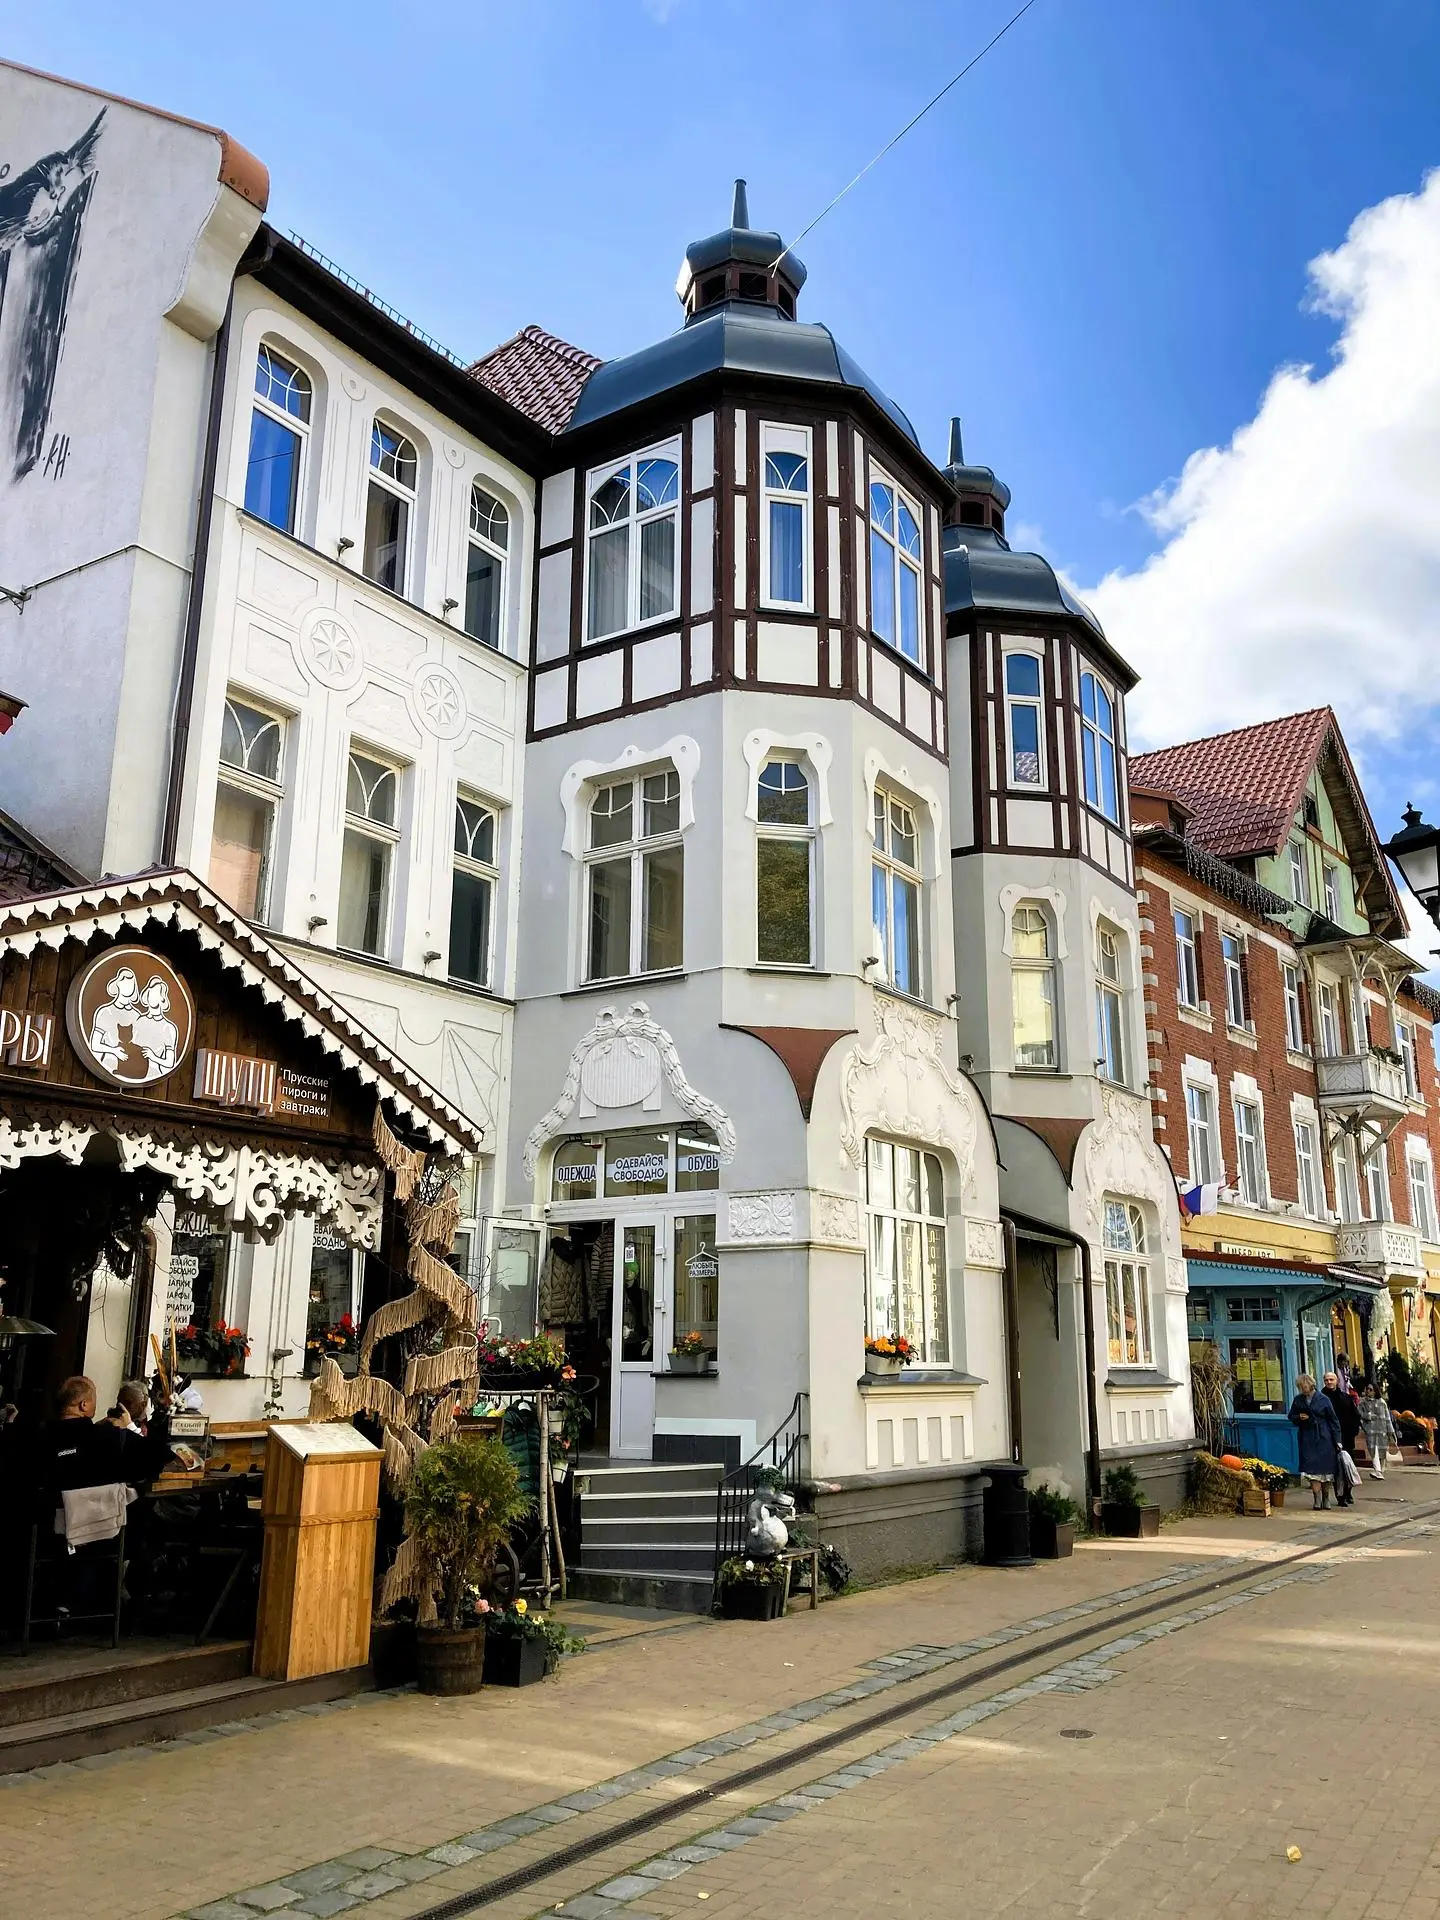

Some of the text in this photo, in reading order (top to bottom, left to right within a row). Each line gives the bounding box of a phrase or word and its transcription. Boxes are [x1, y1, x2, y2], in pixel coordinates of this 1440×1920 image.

[204, 1052, 274, 1113] ШУТЦ
[283, 1069, 329, 1088] Прусские
[282, 1086, 327, 1102] пироги и
[615, 1155, 663, 1169] ОДЕВАЙСЯ
[687, 1155, 719, 1171] ОБУВЬ
[558, 1165, 596, 1182] ОДЕЖДА
[613, 1168, 664, 1181] СВОБОДНО
